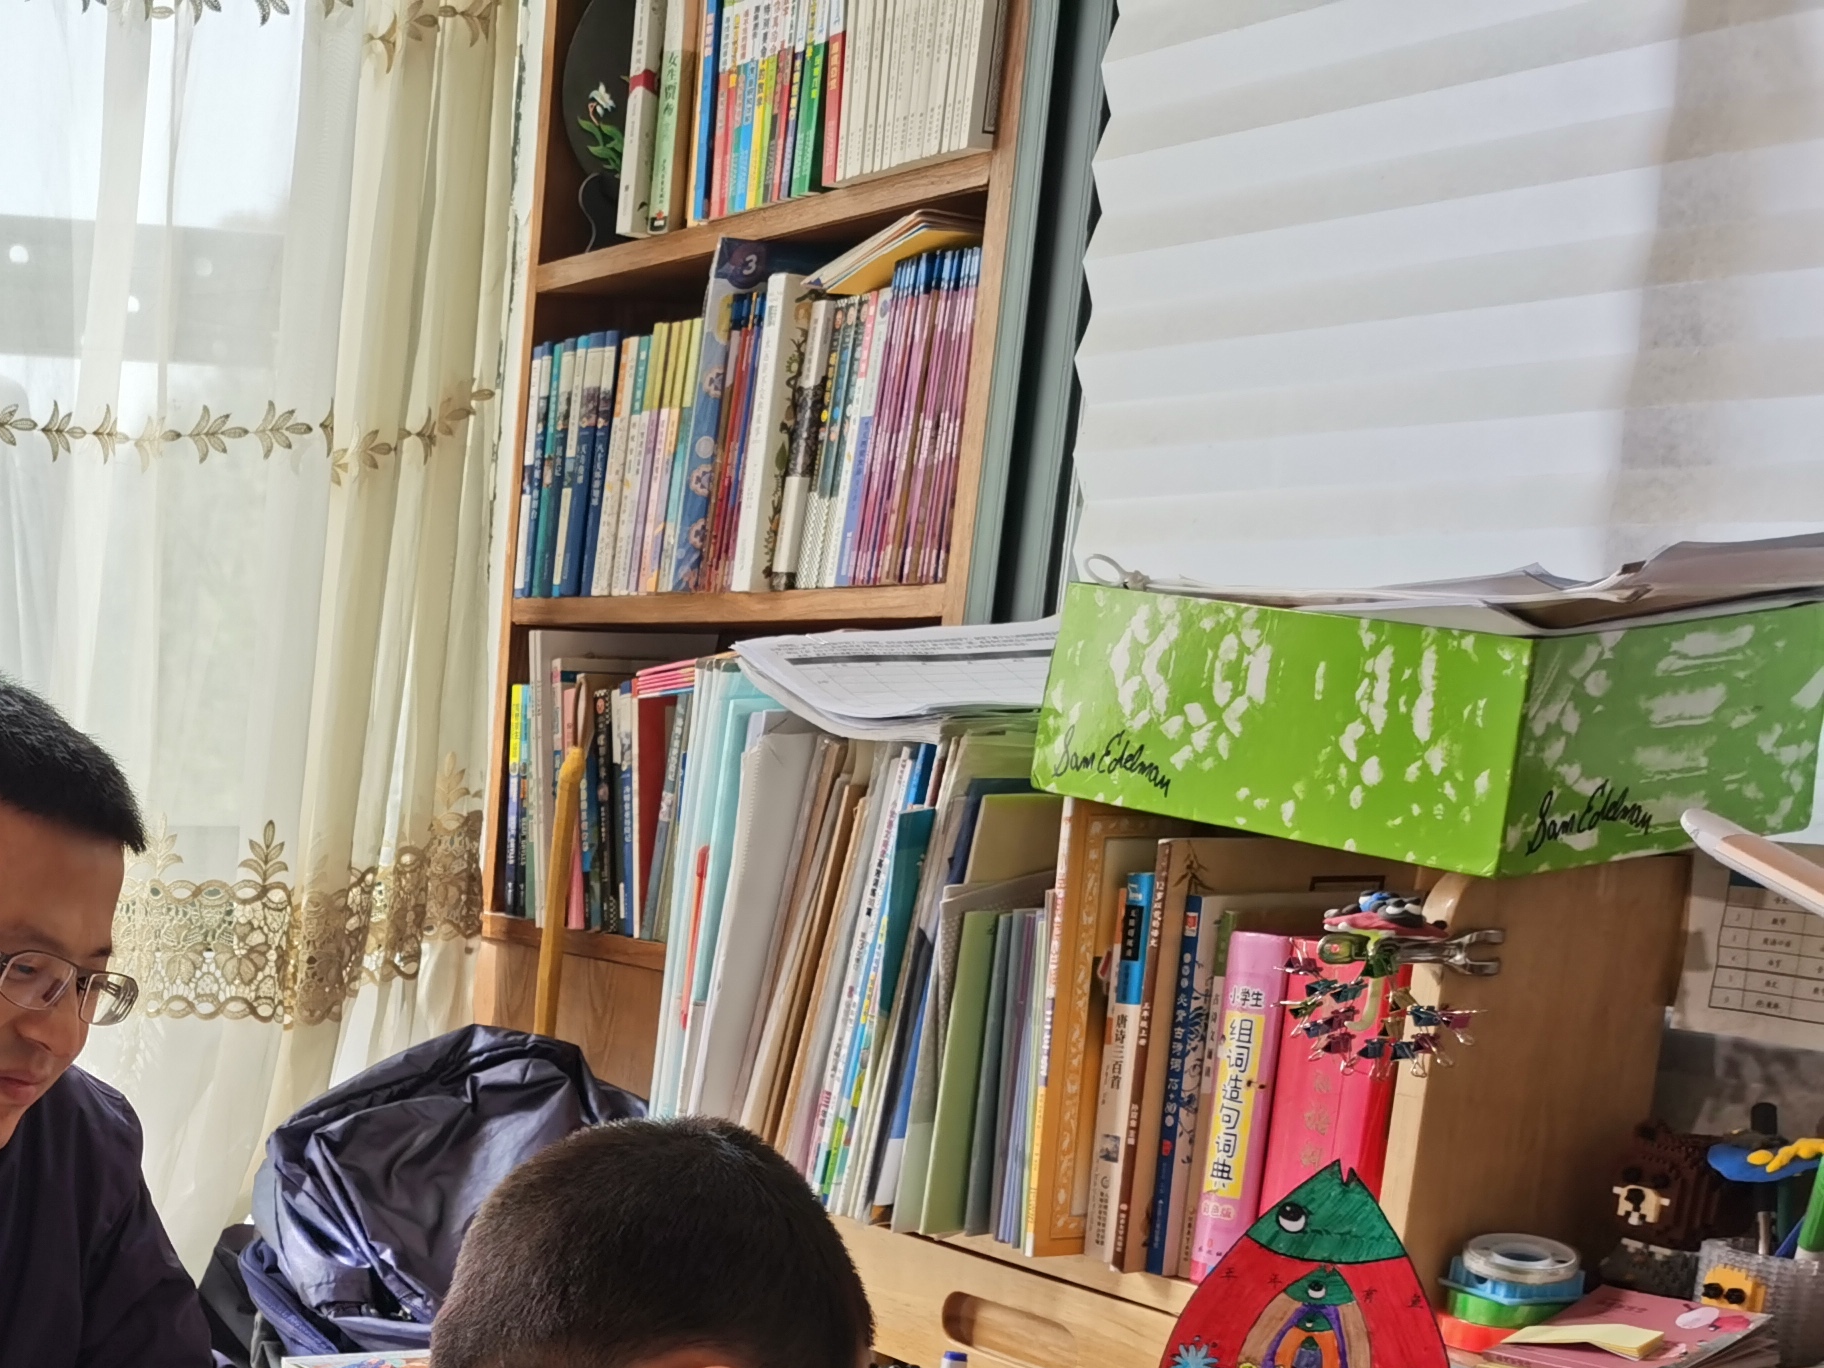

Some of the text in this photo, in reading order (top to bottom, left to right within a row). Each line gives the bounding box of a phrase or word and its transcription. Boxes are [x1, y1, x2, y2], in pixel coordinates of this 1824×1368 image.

[743, 254, 757, 276] 3
[1052, 724, 1171, 798] Sam Edelman
[1524, 778, 1653, 857] Sam Edelman
[1229, 986, 1264, 1008] 小学生
[1110, 1013, 1128, 1091] 唐诗三百首
[1209, 1018, 1255, 1189] 组词造句词典
